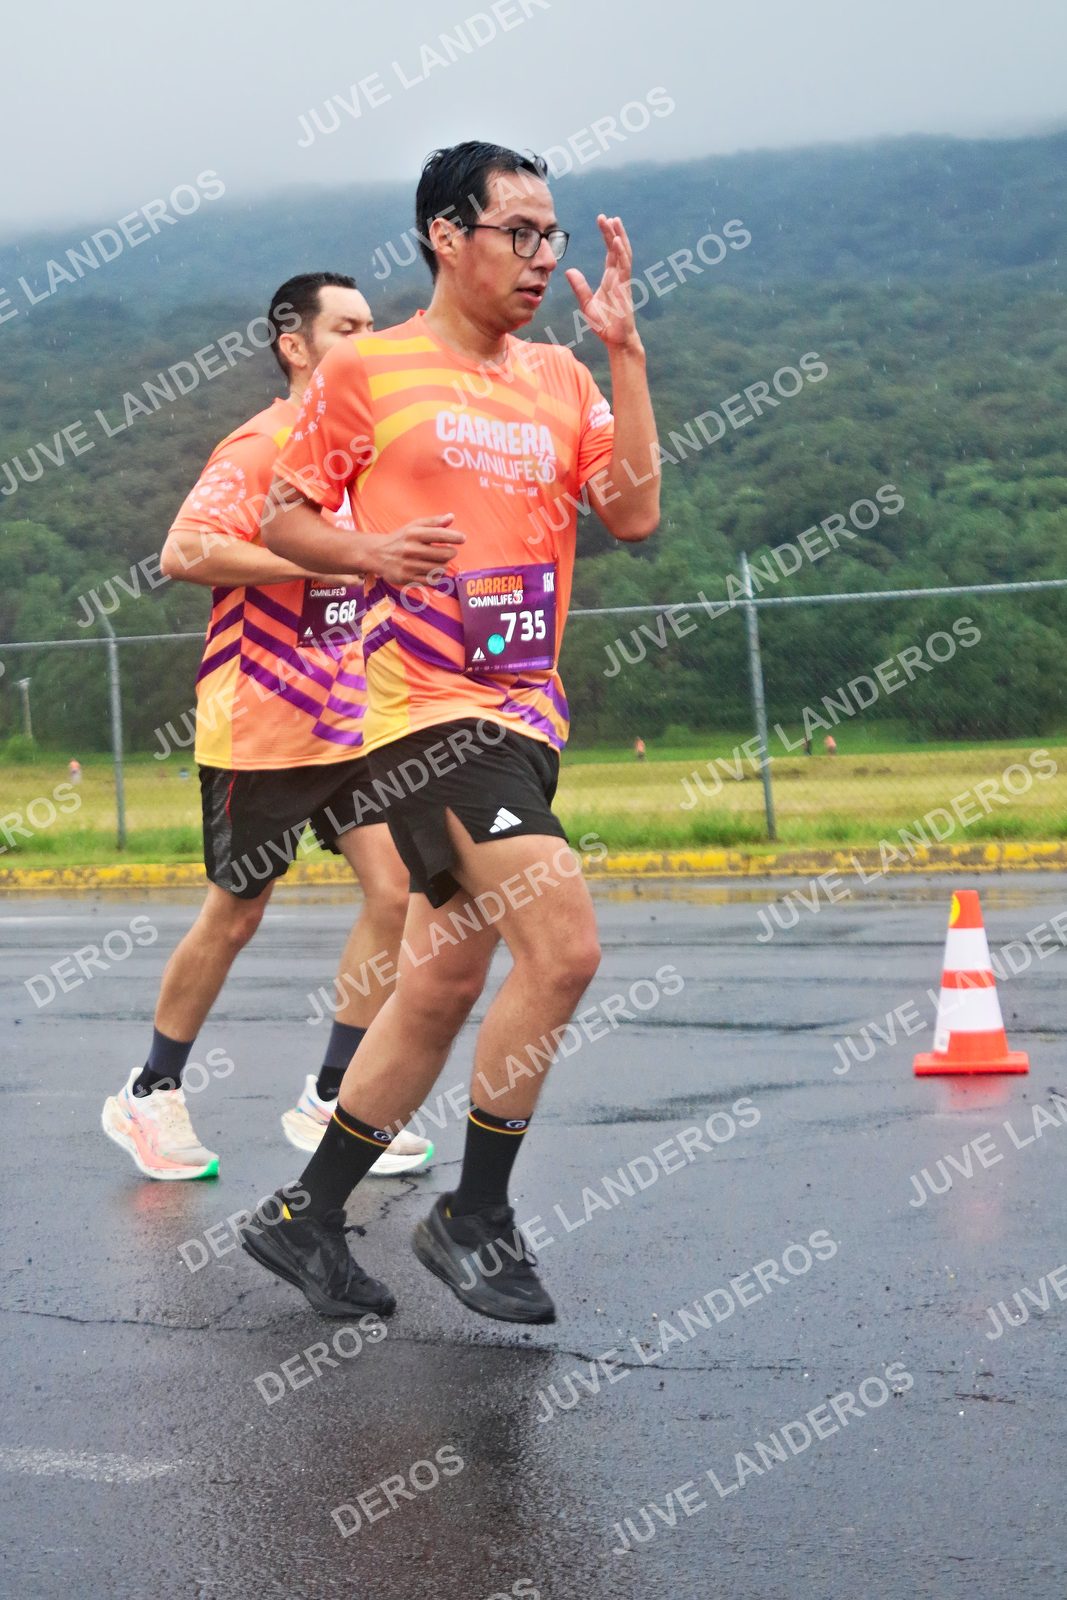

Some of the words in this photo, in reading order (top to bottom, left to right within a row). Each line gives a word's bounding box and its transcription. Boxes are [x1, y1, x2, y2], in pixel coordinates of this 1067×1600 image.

[436, 410, 556, 456] CARRERA
[466, 575, 523, 596] CARRERA
[325, 598, 357, 624] 668
[500, 609, 546, 643] 735
